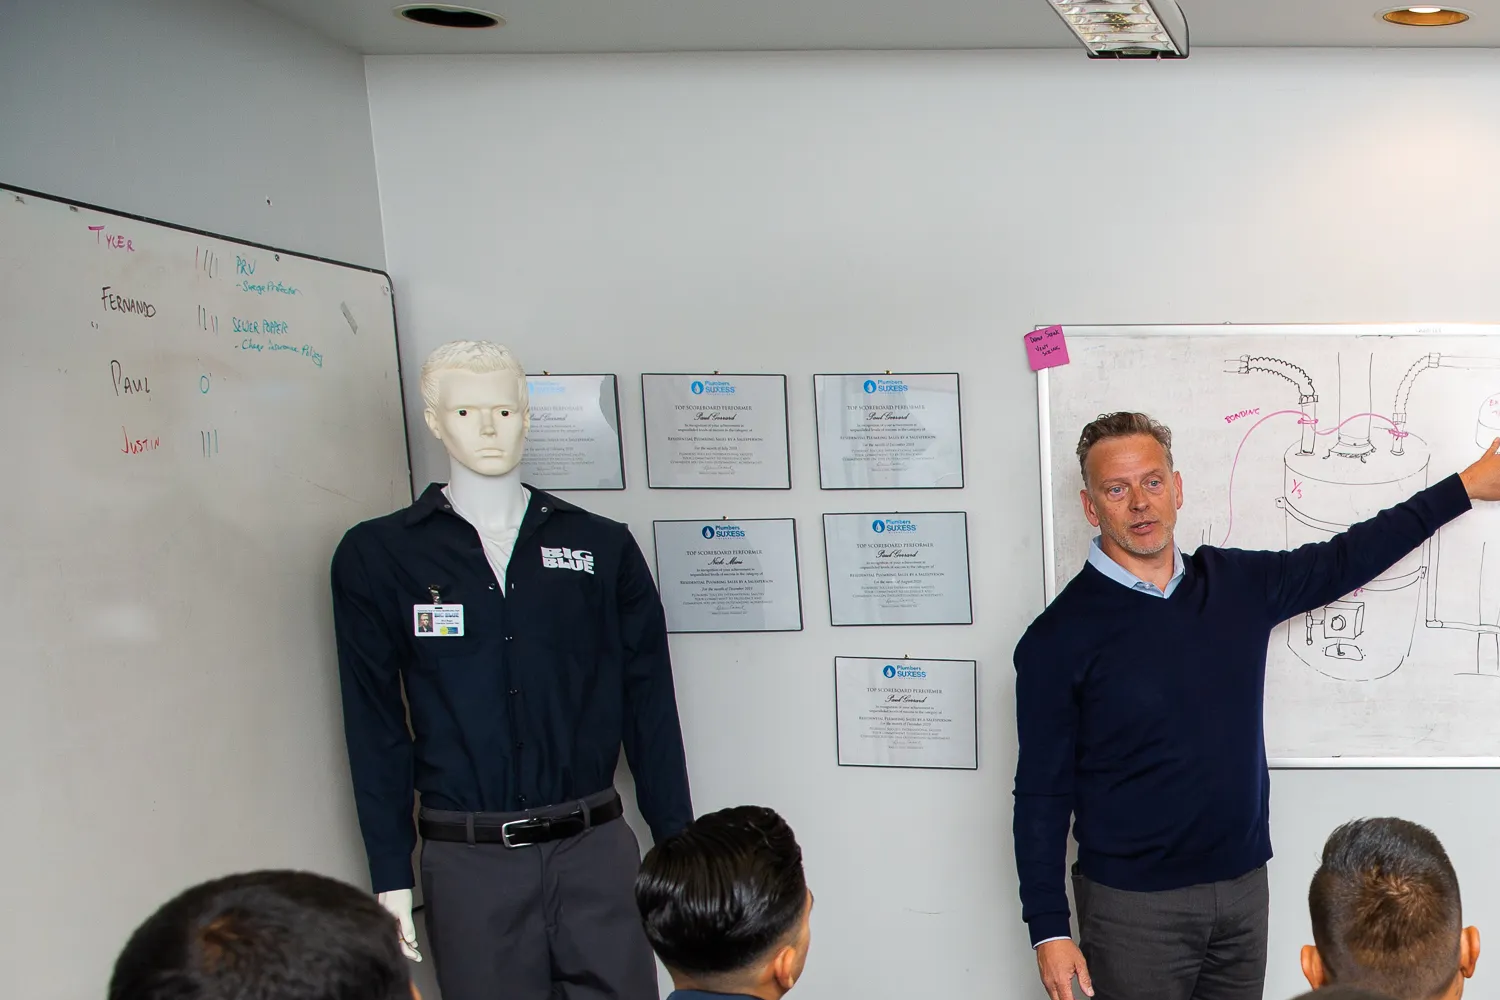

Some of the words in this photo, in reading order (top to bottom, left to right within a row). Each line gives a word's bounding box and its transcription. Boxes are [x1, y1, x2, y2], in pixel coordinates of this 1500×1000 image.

[236, 255, 256, 276] PRV
[101, 286, 156, 318] FERNANDO
[232, 316, 260, 334] SEWER
[541, 546, 594, 562] BIG
[543, 557, 595, 575] BLUE
